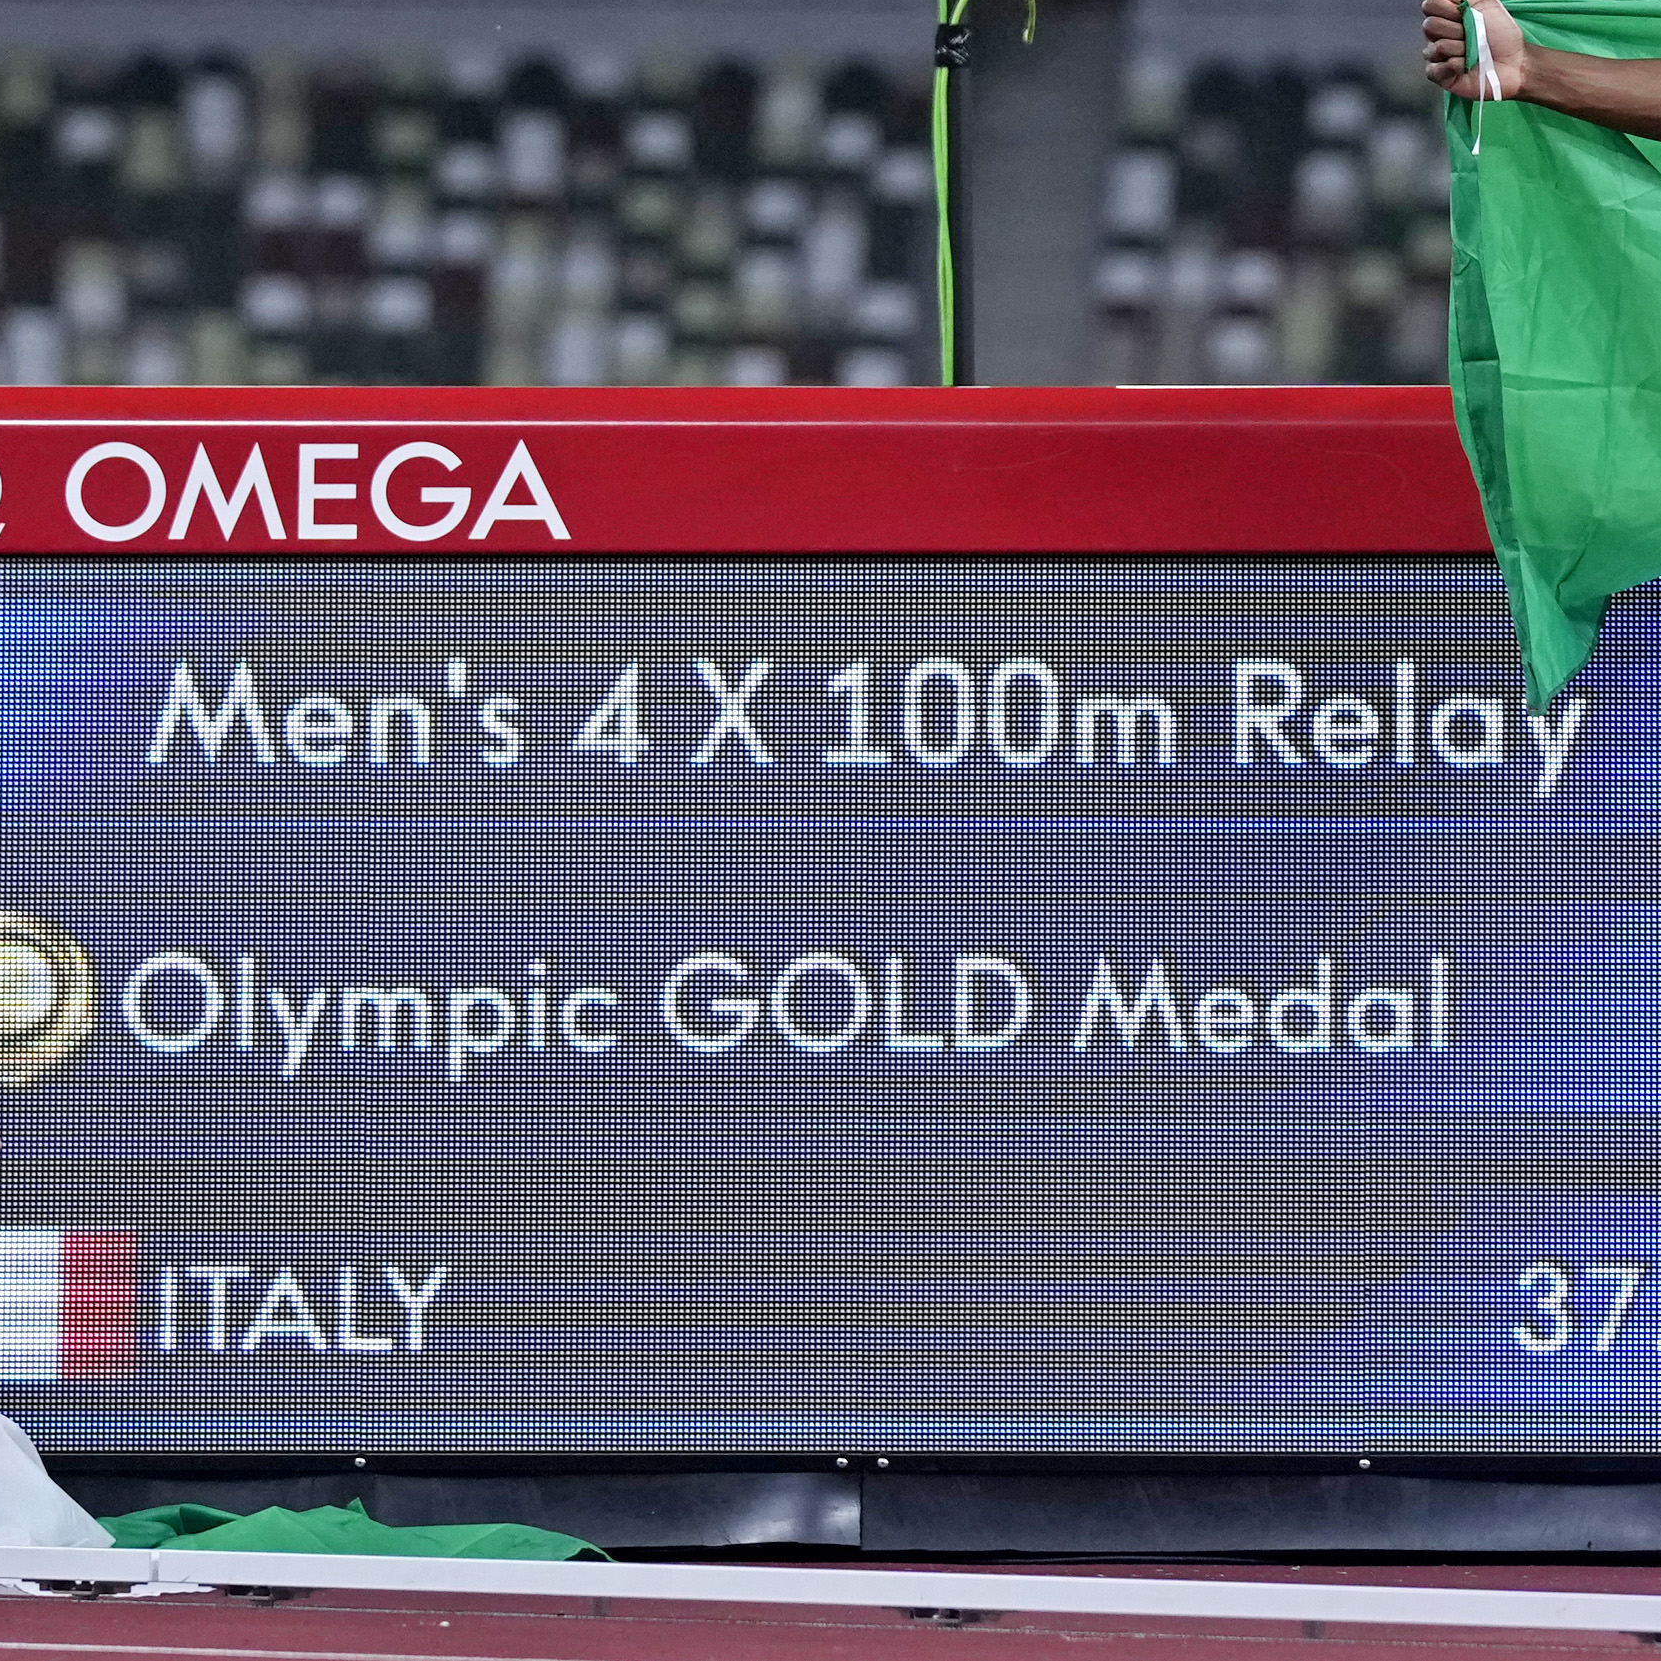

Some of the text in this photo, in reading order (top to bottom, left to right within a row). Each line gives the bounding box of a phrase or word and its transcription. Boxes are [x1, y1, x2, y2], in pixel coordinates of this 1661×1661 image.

[65, 439, 571, 542] OMEGA
[142, 660, 1587, 798] Men's 4 X 100m Relay
[122, 952, 1451, 1084] Olympic GOLD Medal
[160, 1261, 448, 1354] ITALY
